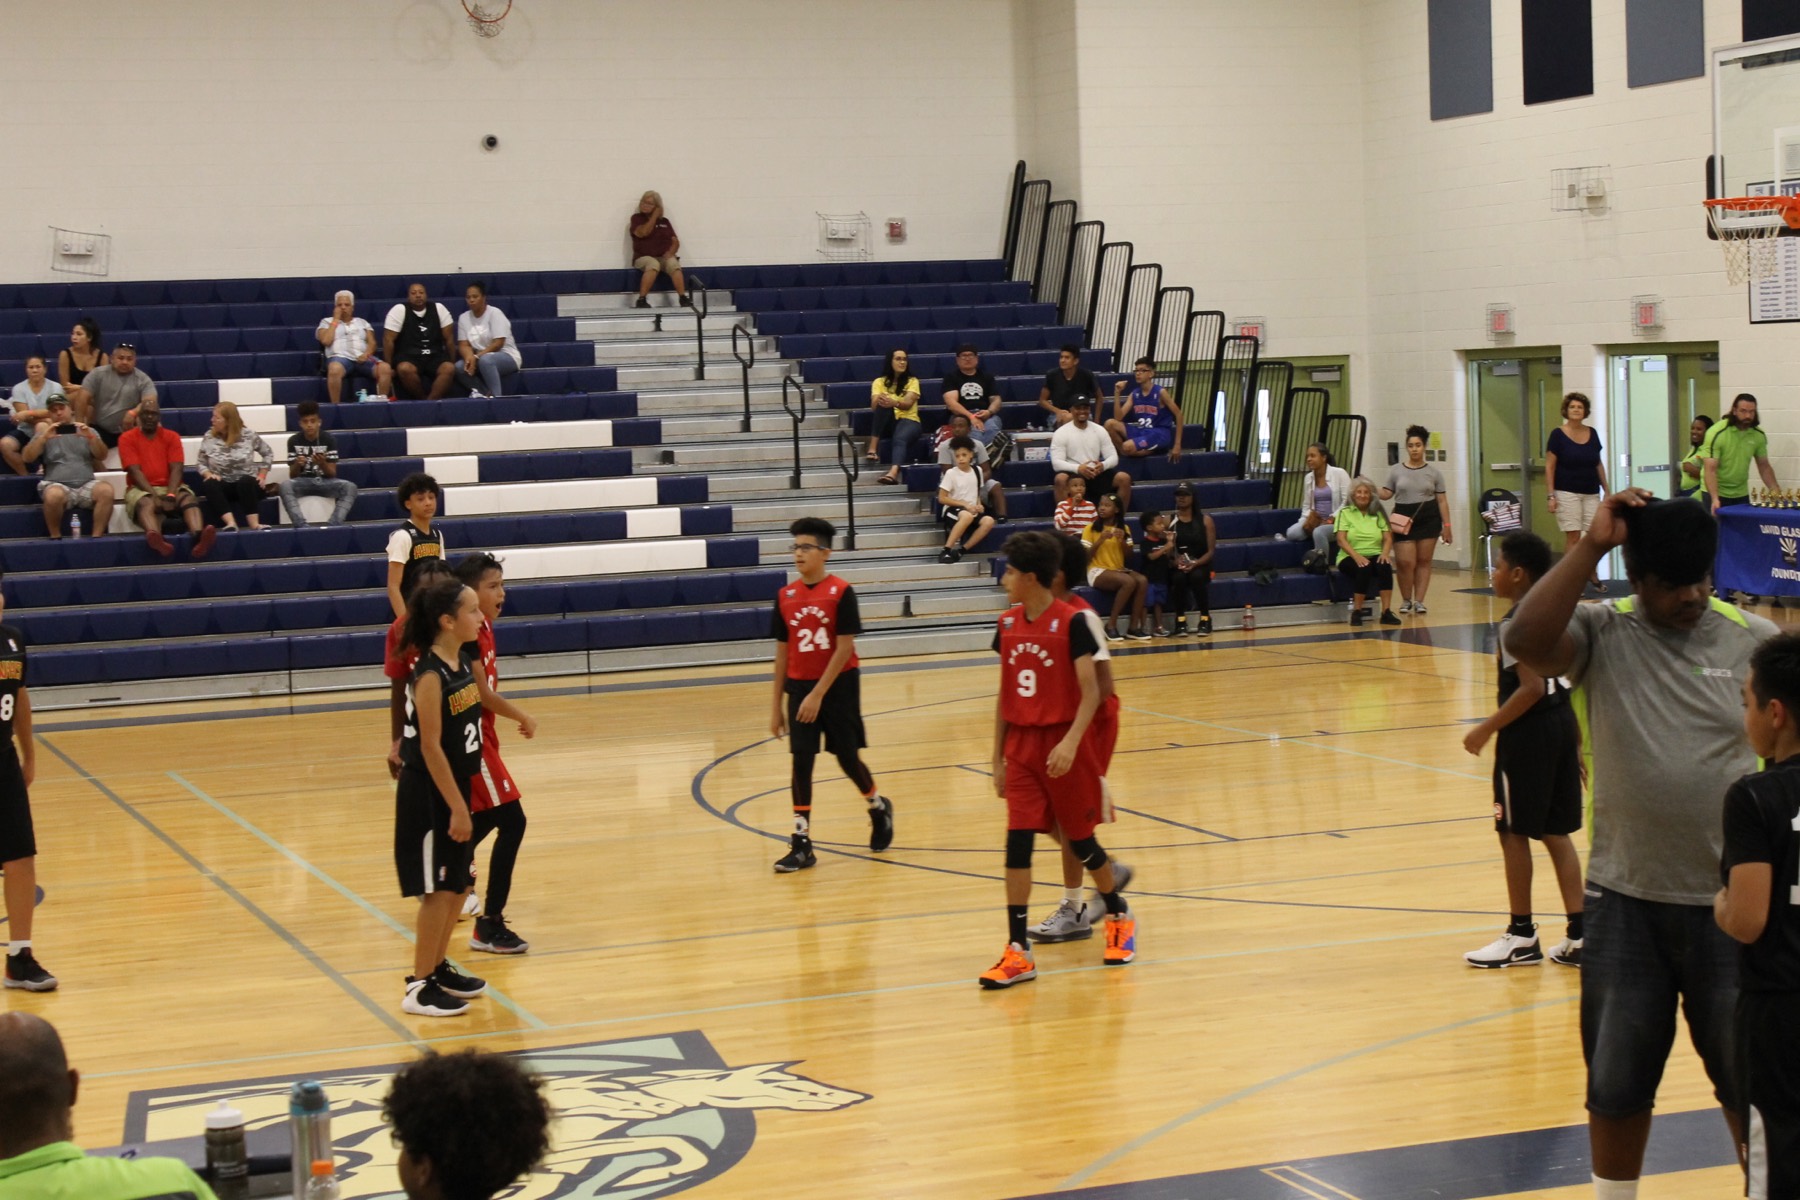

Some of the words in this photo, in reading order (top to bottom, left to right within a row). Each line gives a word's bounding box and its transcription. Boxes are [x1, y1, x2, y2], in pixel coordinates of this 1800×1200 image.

[1760, 524, 1780, 535] DAVID
[797, 627, 831, 652] 24
[1016, 669, 1037, 698] 9
[0, 693, 15, 721] 8
